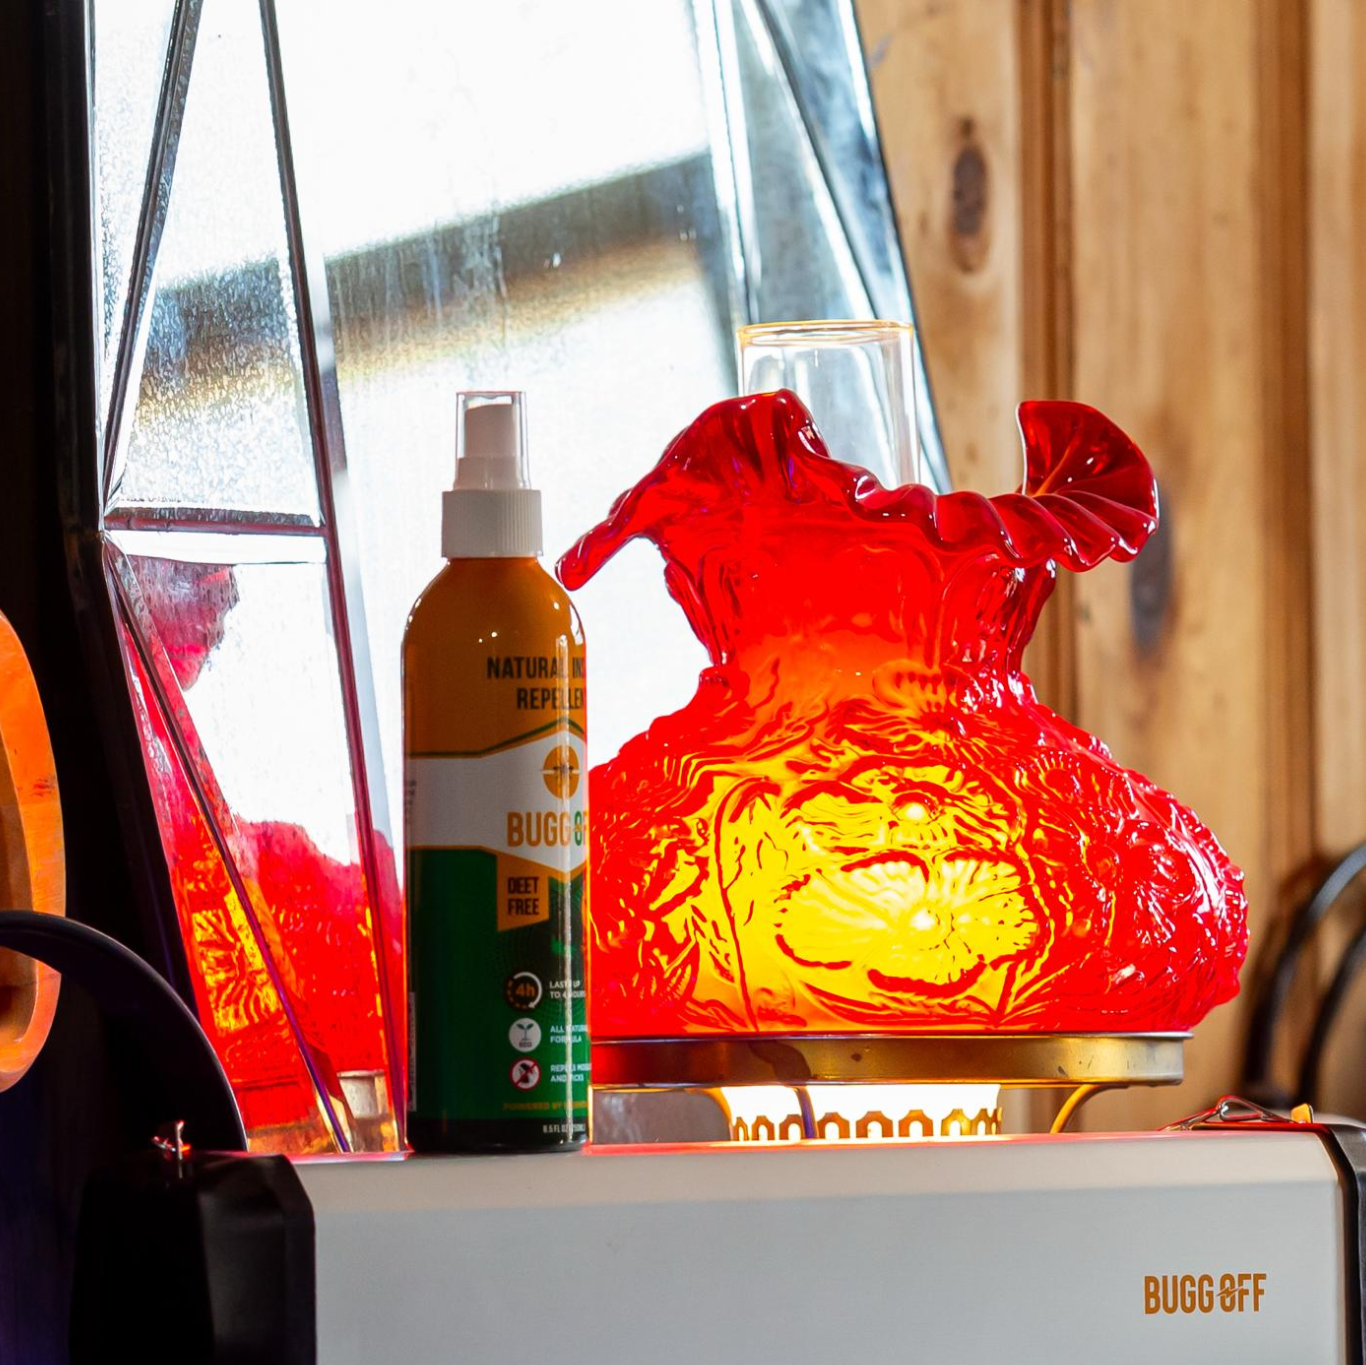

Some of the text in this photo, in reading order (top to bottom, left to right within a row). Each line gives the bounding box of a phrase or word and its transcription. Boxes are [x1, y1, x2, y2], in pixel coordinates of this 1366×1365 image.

[508, 876, 539, 893] DEET
[508, 898, 539, 915] FREE
[515, 983, 536, 997] 4h
[1144, 1273, 1267, 1315] BUGG OFF
